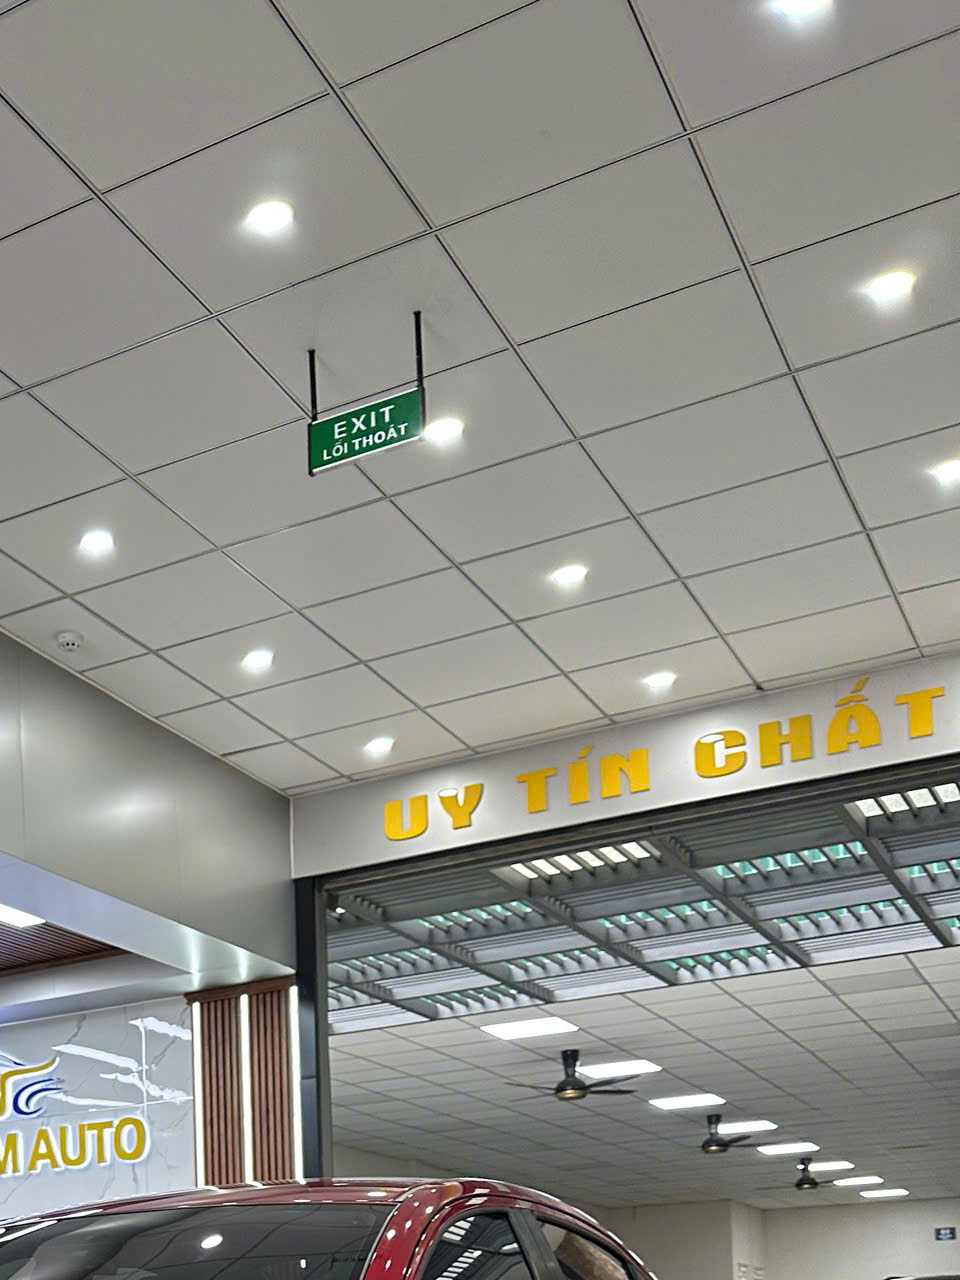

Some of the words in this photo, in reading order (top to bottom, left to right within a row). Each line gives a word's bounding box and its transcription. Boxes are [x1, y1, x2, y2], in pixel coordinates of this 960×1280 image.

[333, 405, 395, 440] EXIT
[351, 423, 408, 450] THOÁT
[383, 783, 483, 841] UY
[515, 745, 651, 814] TÍN
[694, 677, 946, 779] CHẤT
[28, 1117, 147, 1172] AUTO
